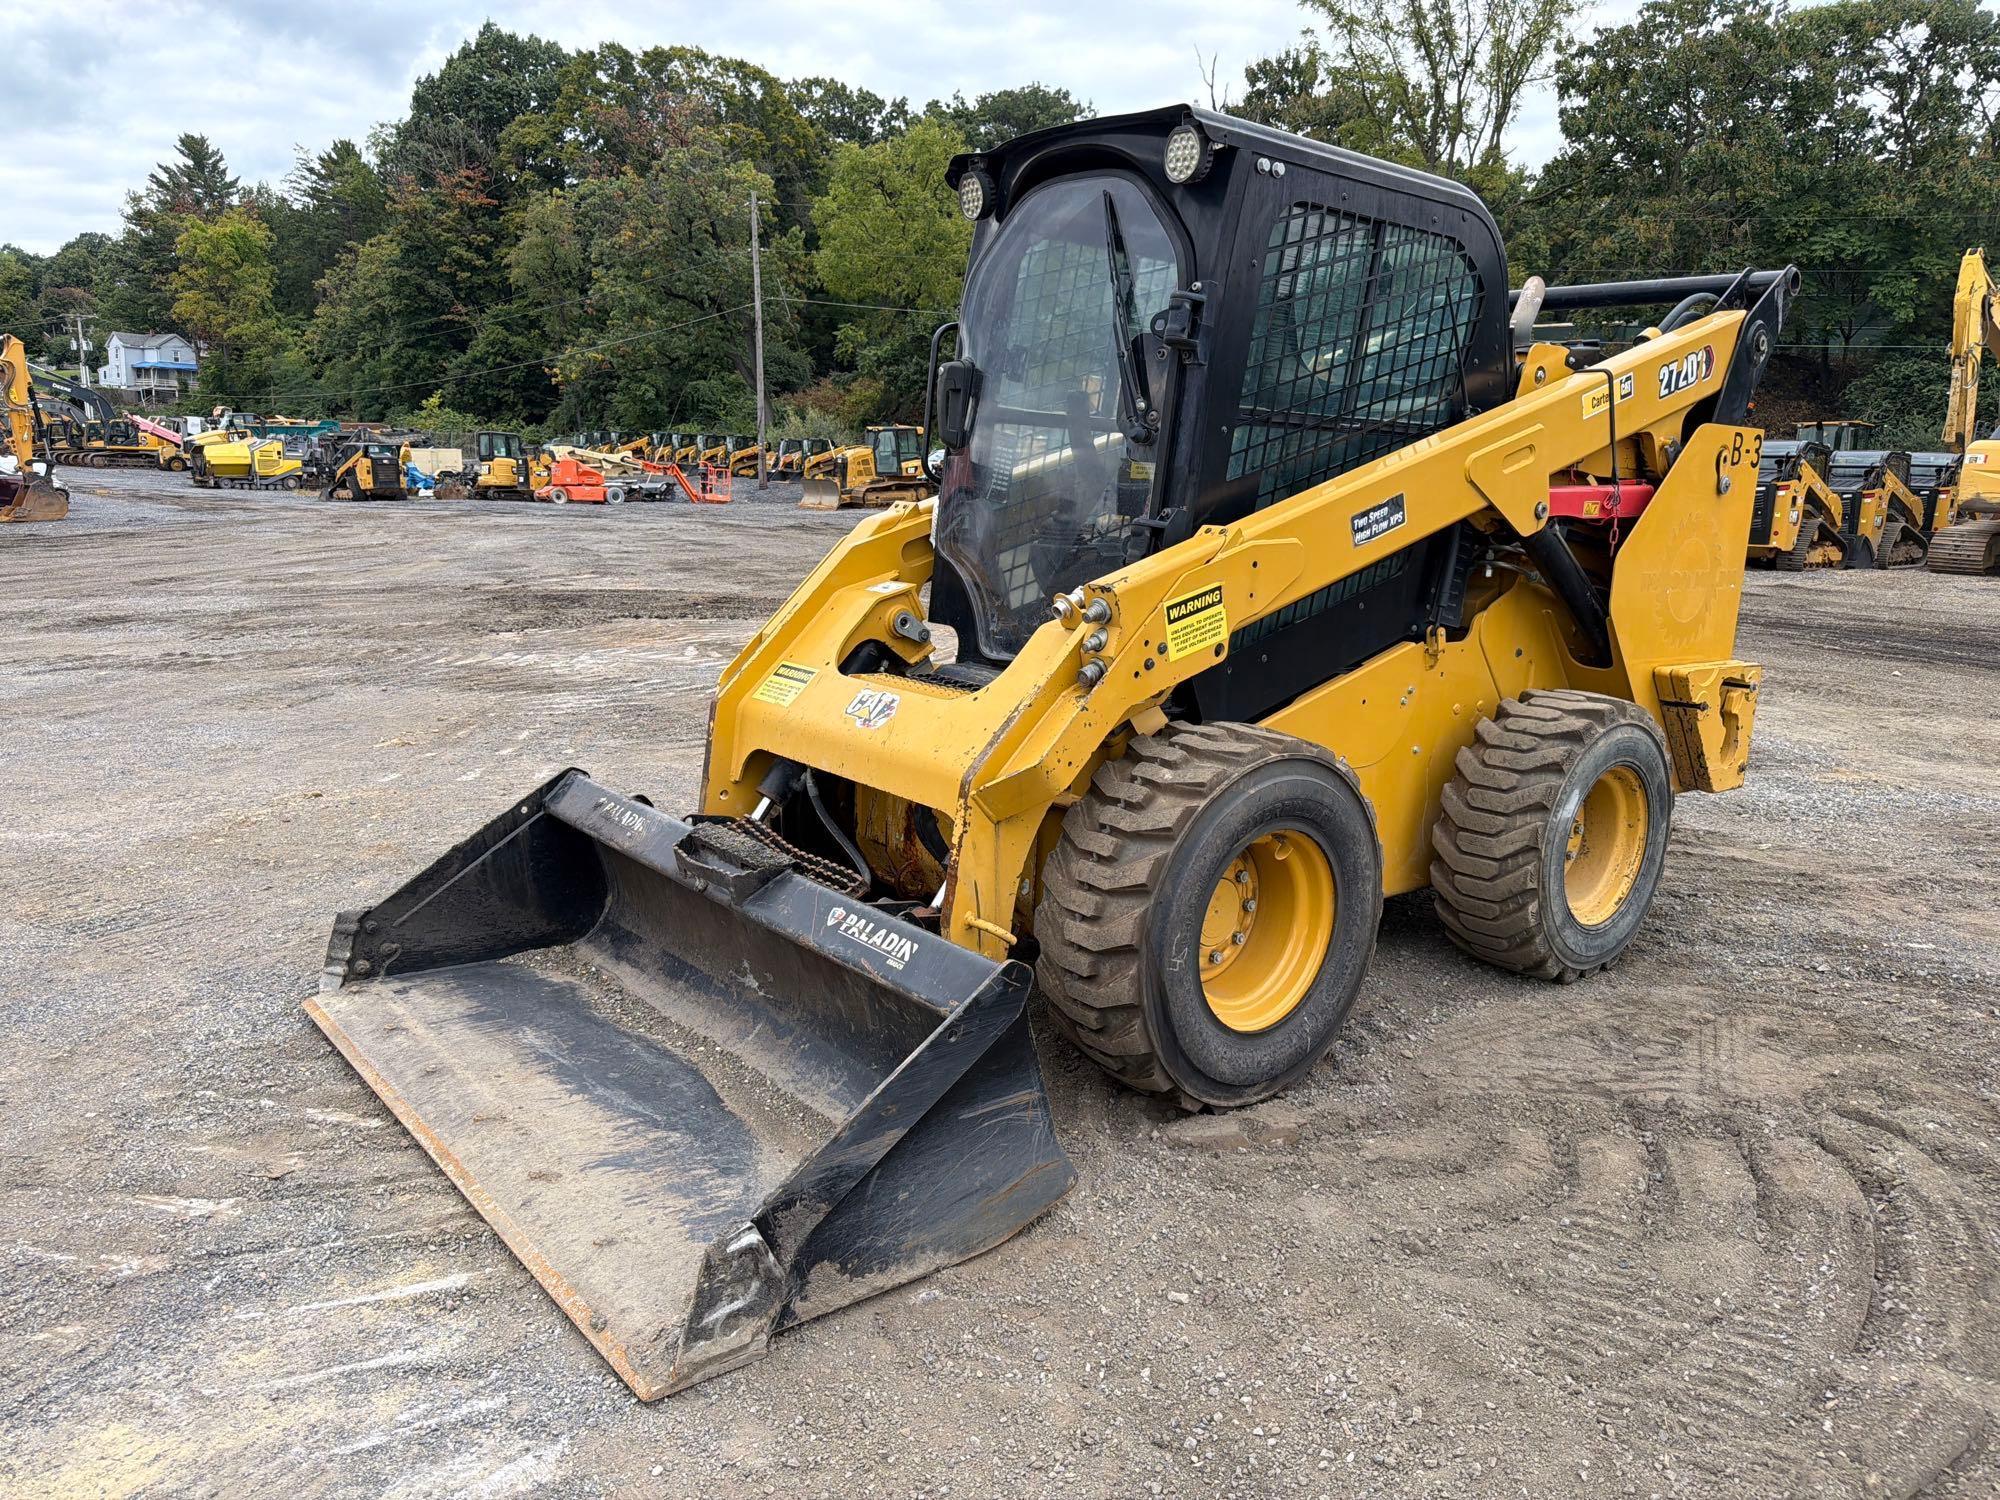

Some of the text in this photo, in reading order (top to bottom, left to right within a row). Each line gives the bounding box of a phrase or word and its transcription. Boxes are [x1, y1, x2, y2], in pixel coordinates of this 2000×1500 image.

[1592, 393, 1609, 408] Carte
[1731, 432, 1762, 468] B-3
[1390, 511, 1403, 526] XPS
[1169, 591, 1220, 619] WARNING
[776, 667, 812, 681] WARNING
[838, 913, 919, 962] PALADIN
